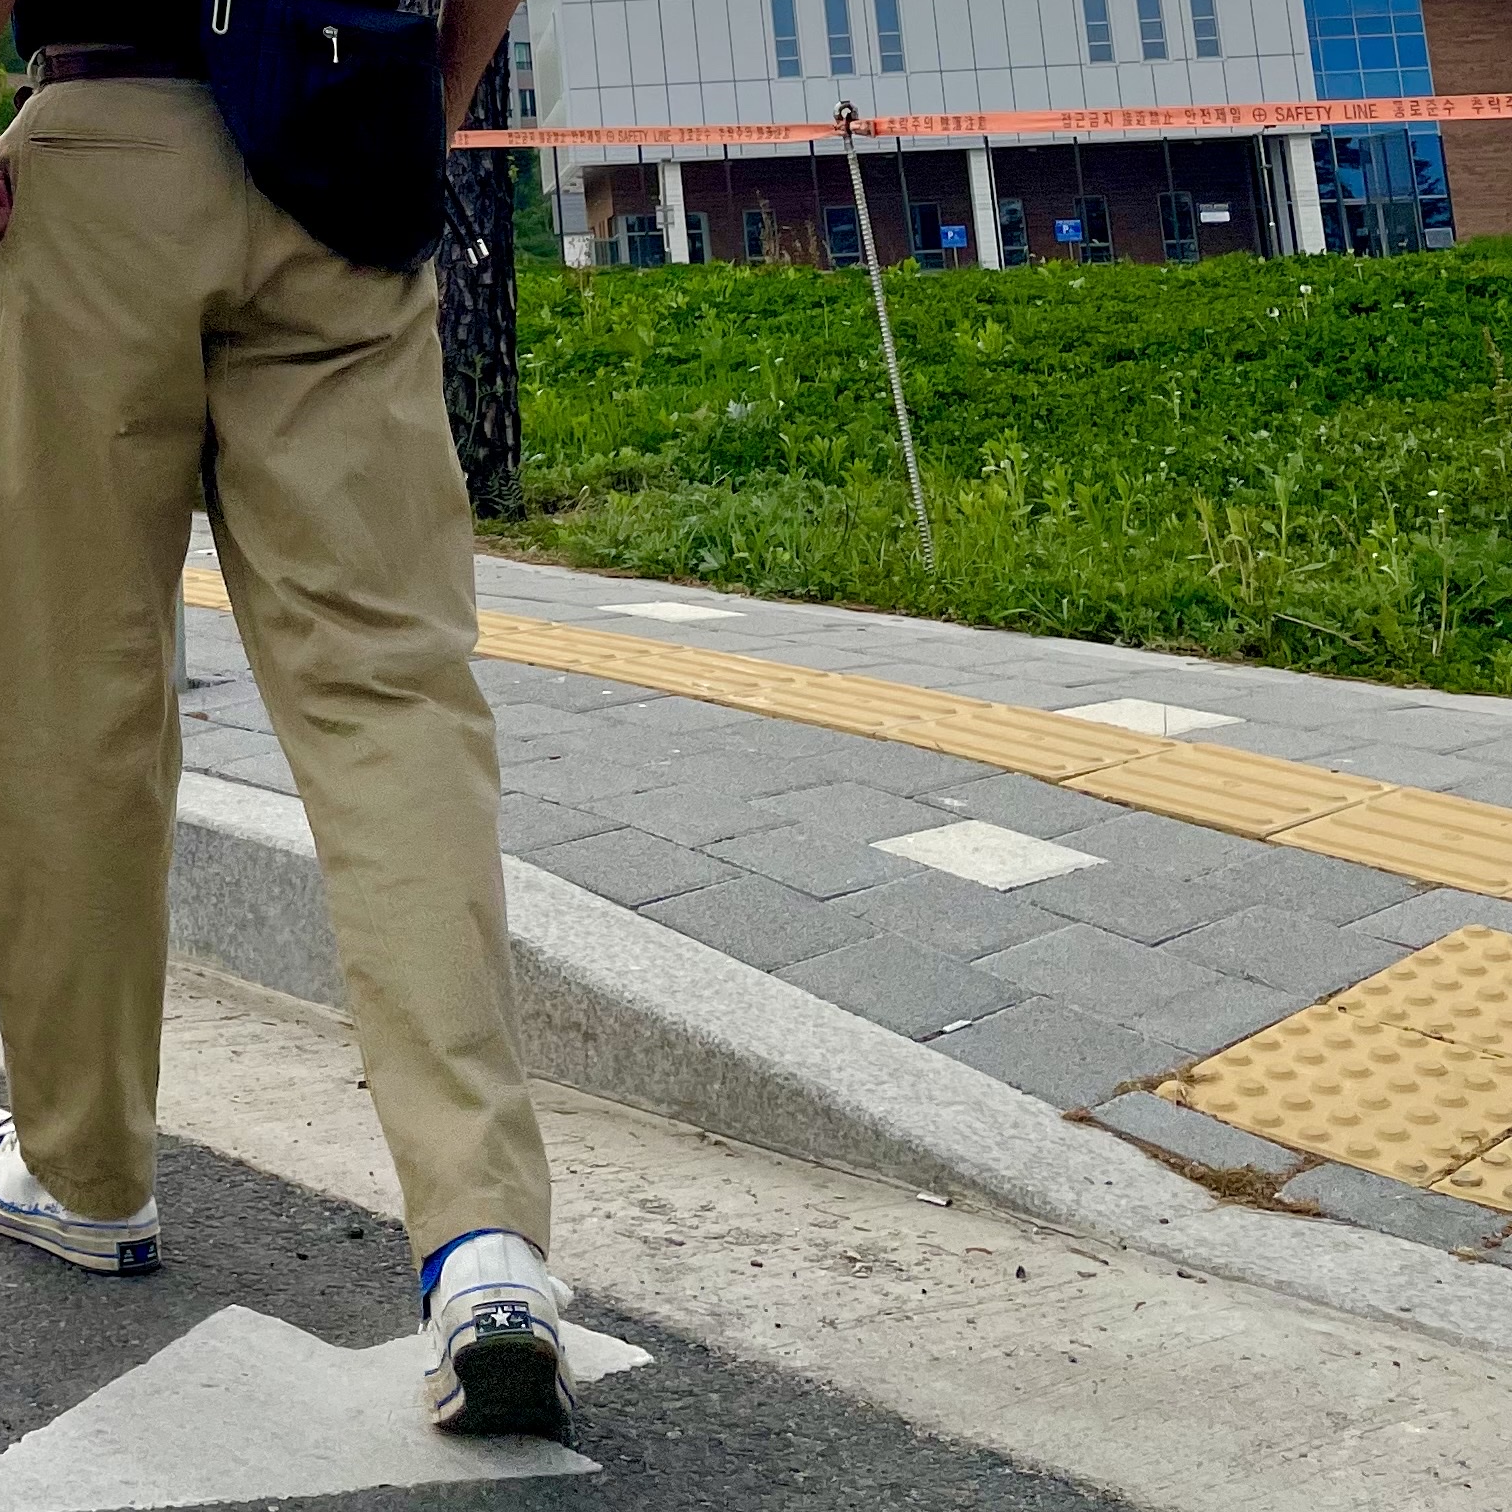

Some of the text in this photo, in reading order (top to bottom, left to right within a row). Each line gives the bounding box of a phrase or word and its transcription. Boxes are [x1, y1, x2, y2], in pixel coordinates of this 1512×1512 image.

[618, 129, 648, 143] SAFETY
[653, 129, 671, 143] LINE
[887, 116, 933, 133] 추락주의
[1061, 111, 1113, 129] 접근금지
[1185, 107, 1241, 125] 안전제일
[1275, 105, 1332, 122] SAFETY
[1344, 103, 1377, 119] LINE
